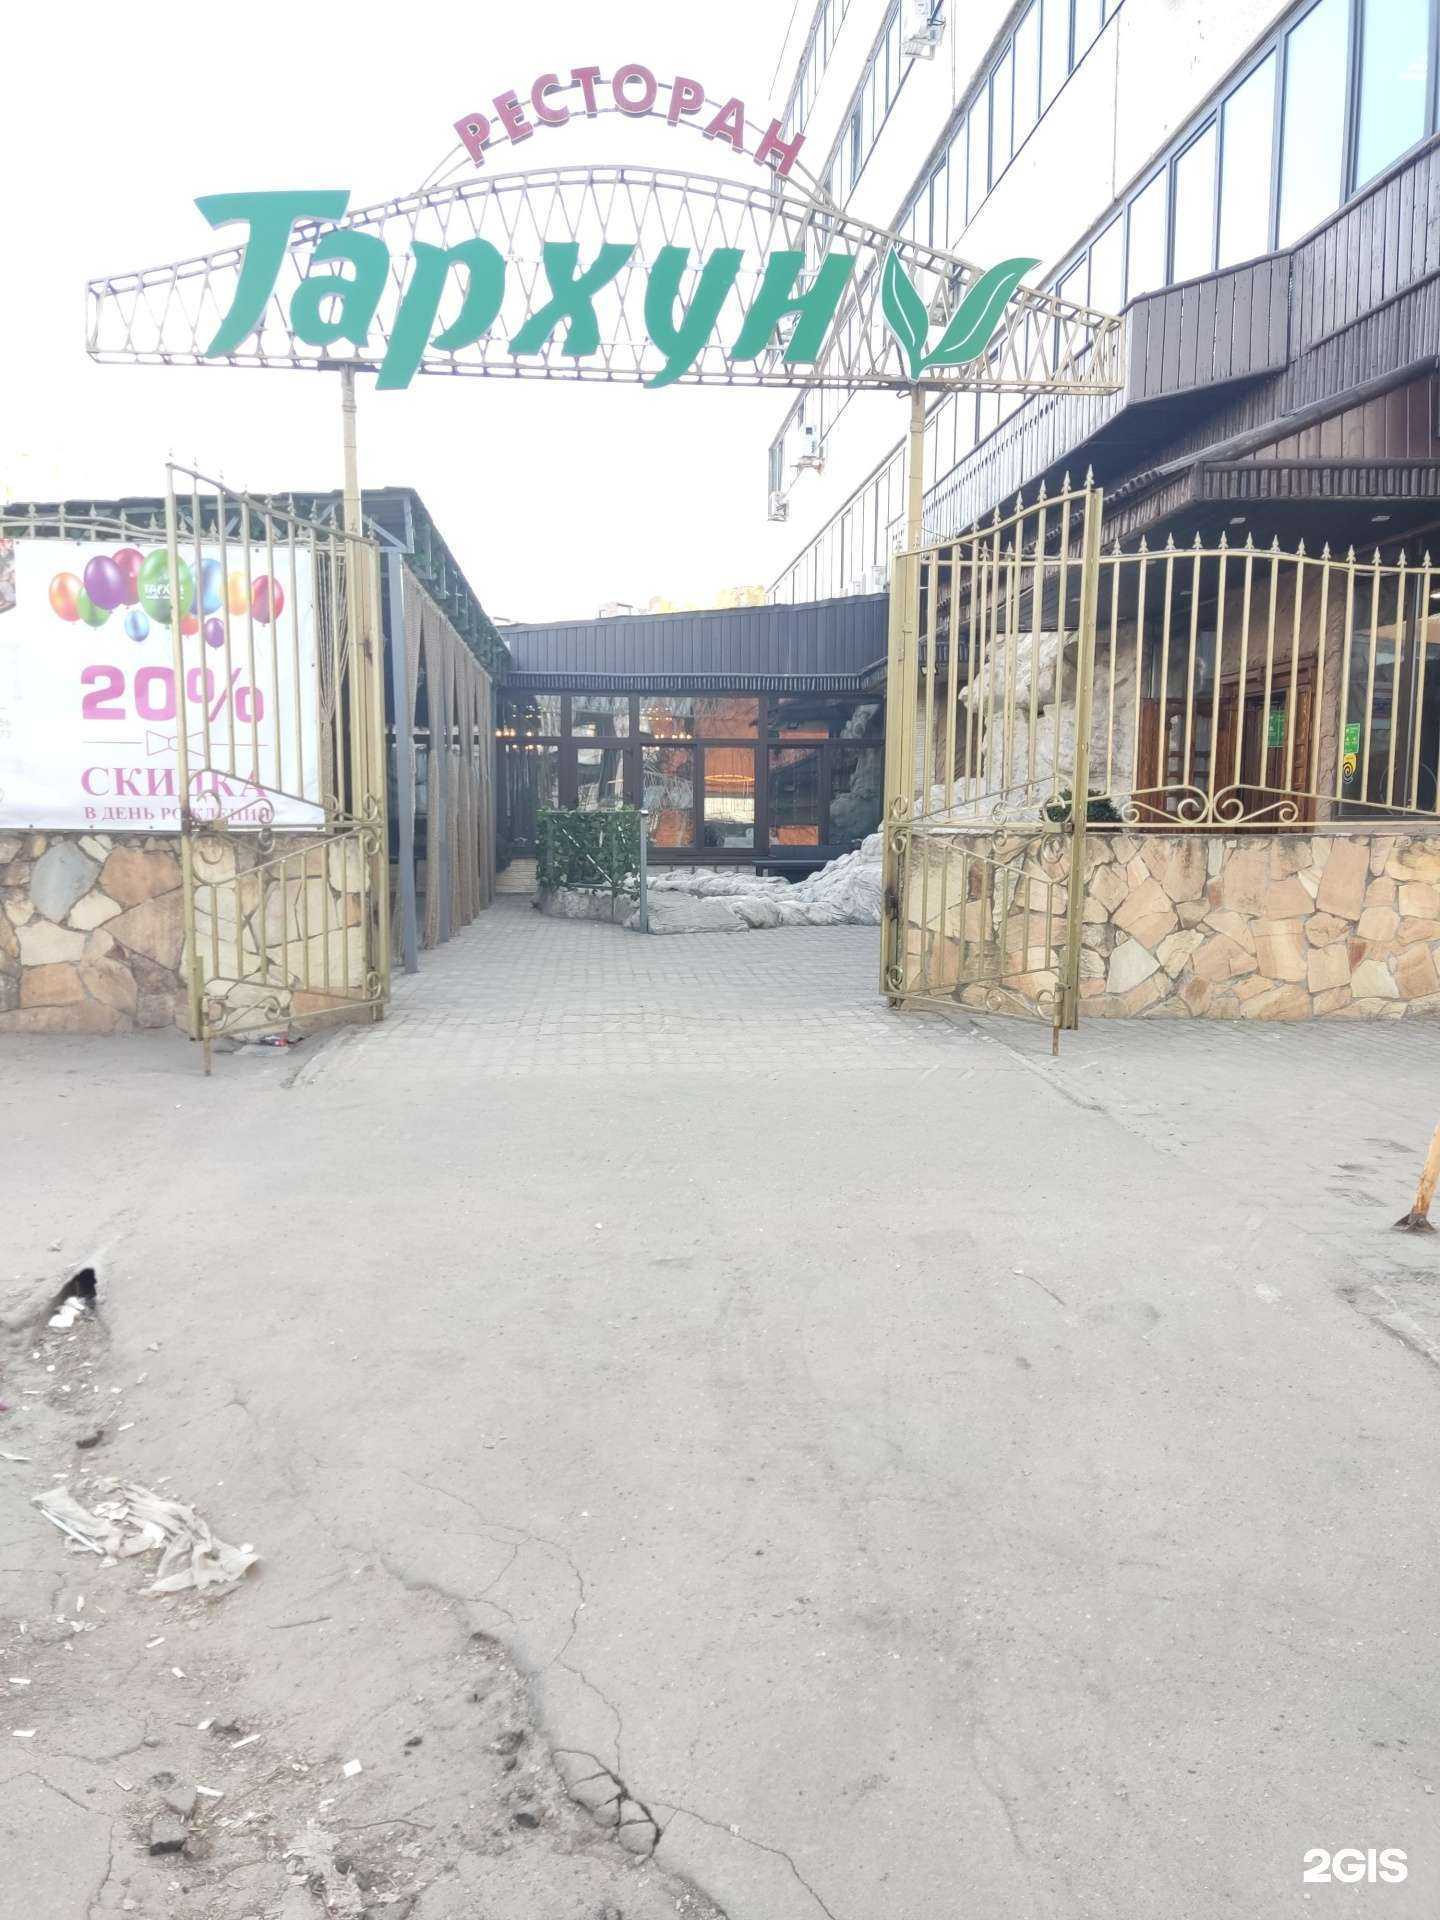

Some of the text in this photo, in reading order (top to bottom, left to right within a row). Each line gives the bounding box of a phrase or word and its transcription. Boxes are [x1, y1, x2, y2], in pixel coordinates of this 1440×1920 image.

[453, 64, 806, 177] РЕСТОРАН
[194, 189, 857, 390] Тархун
[80, 665, 264, 723] 20%
[84, 806, 97, 820] В
[102, 806, 155, 821] ДЕНЬ
